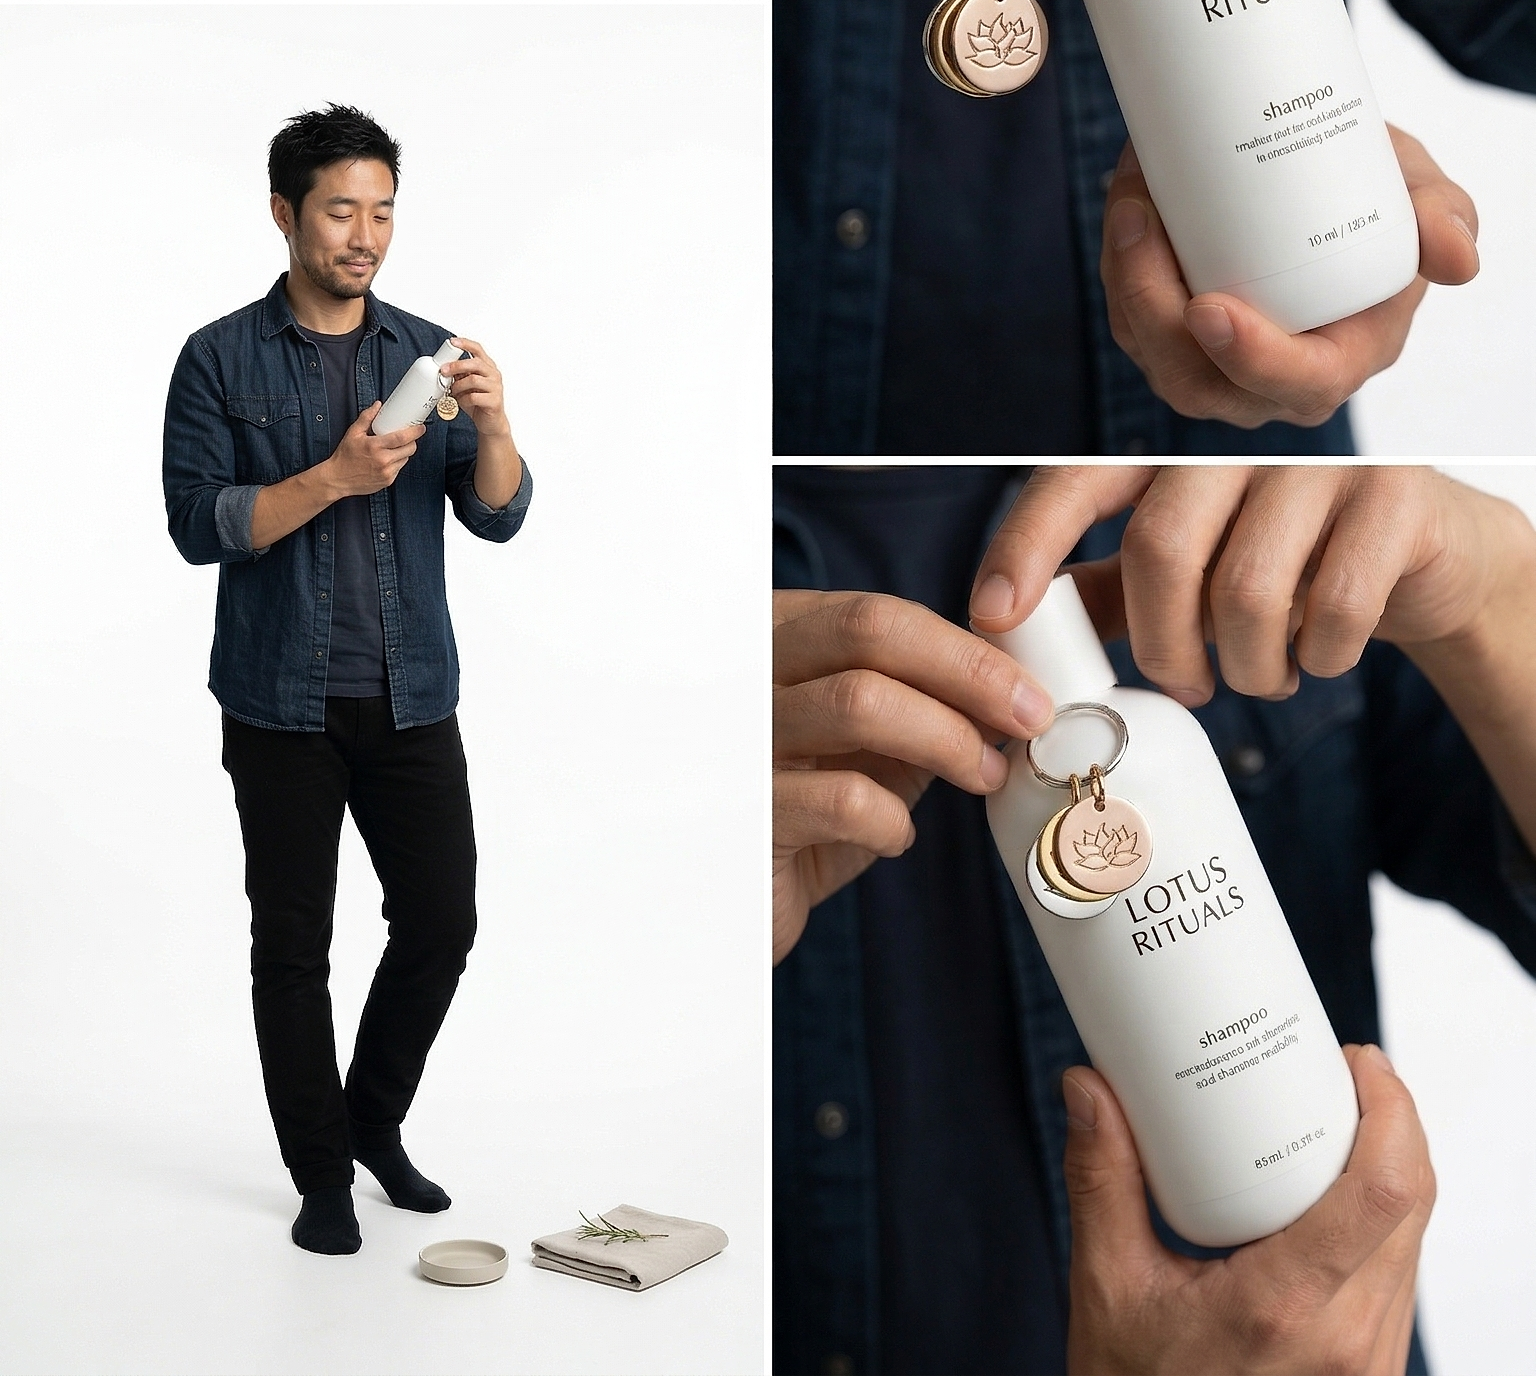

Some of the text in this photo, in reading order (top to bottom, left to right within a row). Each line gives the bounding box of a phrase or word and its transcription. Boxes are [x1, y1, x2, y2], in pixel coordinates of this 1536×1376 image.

[1263, 84, 1334, 122] shampoo
[1124, 856, 1228, 924] LOTUS
[1131, 886, 1245, 956] RITUALS
[1199, 1007, 1269, 1049] shampoo
